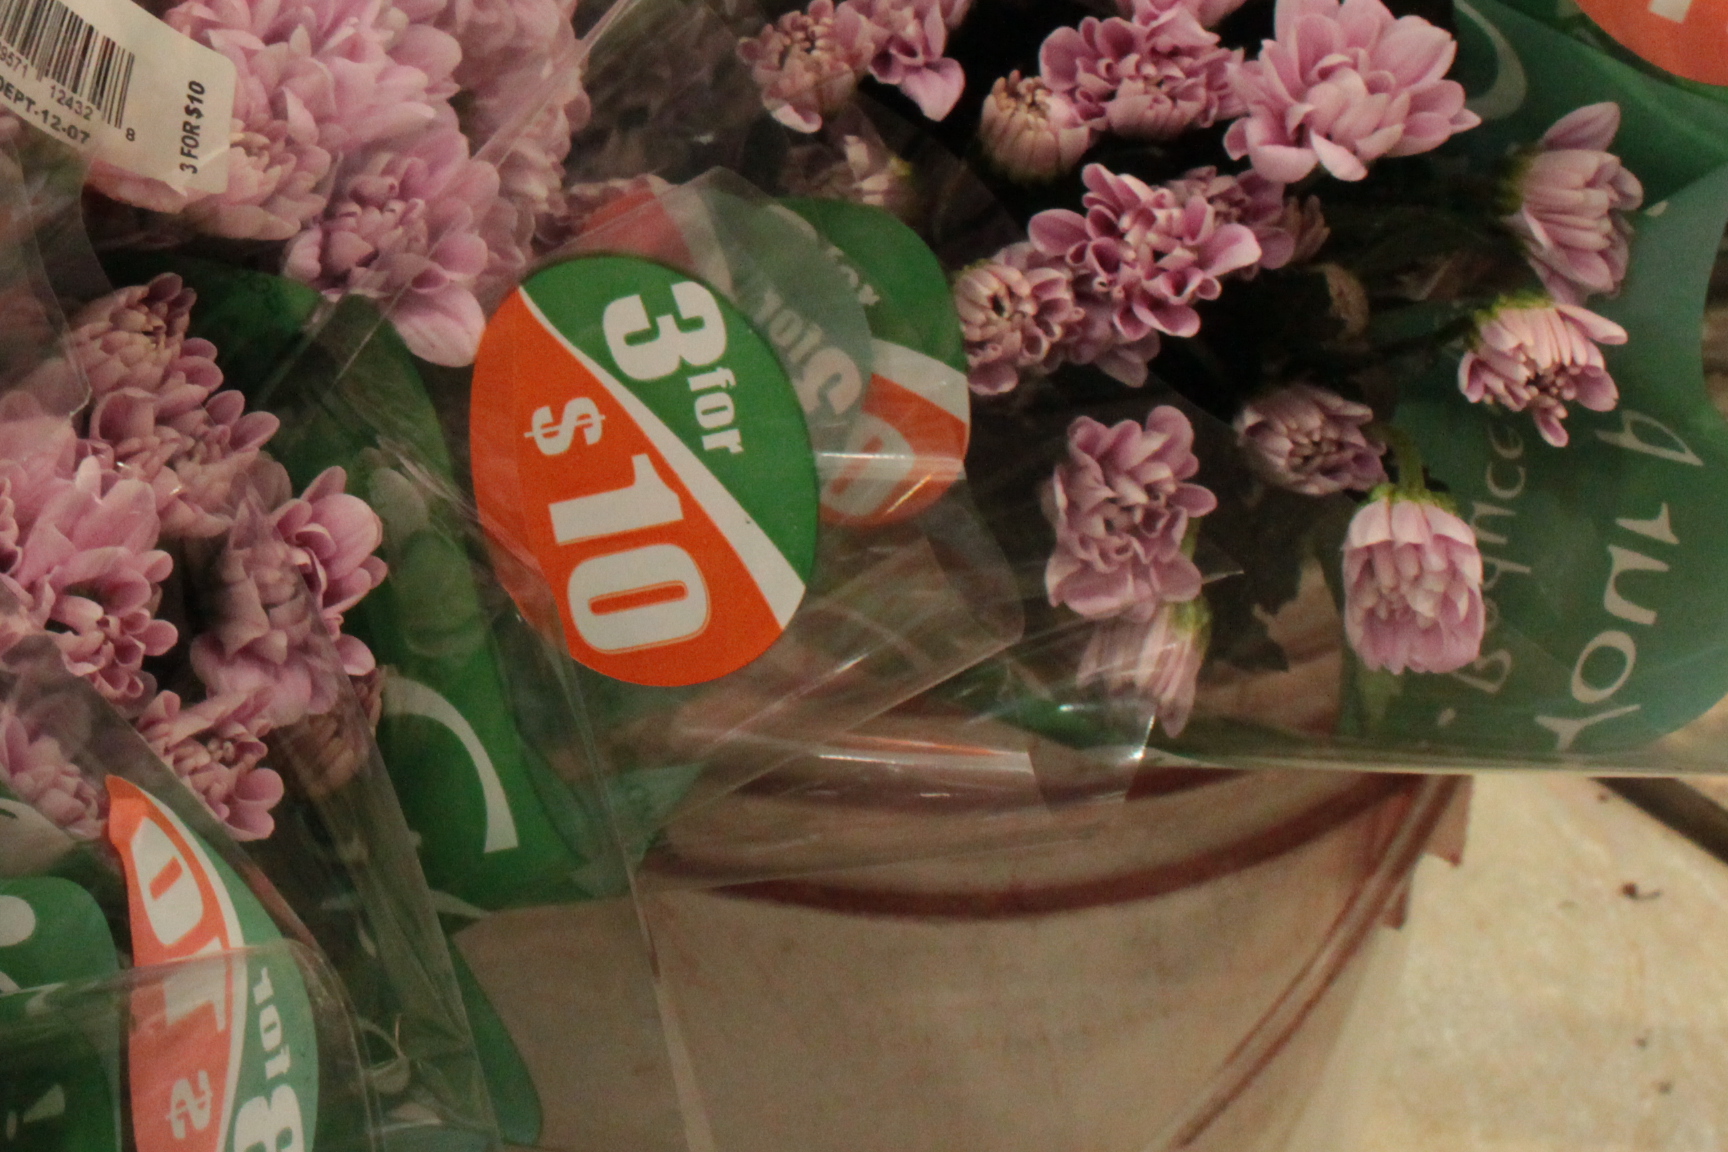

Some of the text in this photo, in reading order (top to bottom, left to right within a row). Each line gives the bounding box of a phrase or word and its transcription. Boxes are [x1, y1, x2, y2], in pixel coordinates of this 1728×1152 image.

[179, 80, 206, 175] 3 FOR $10
[603, 280, 745, 454] 3 for
